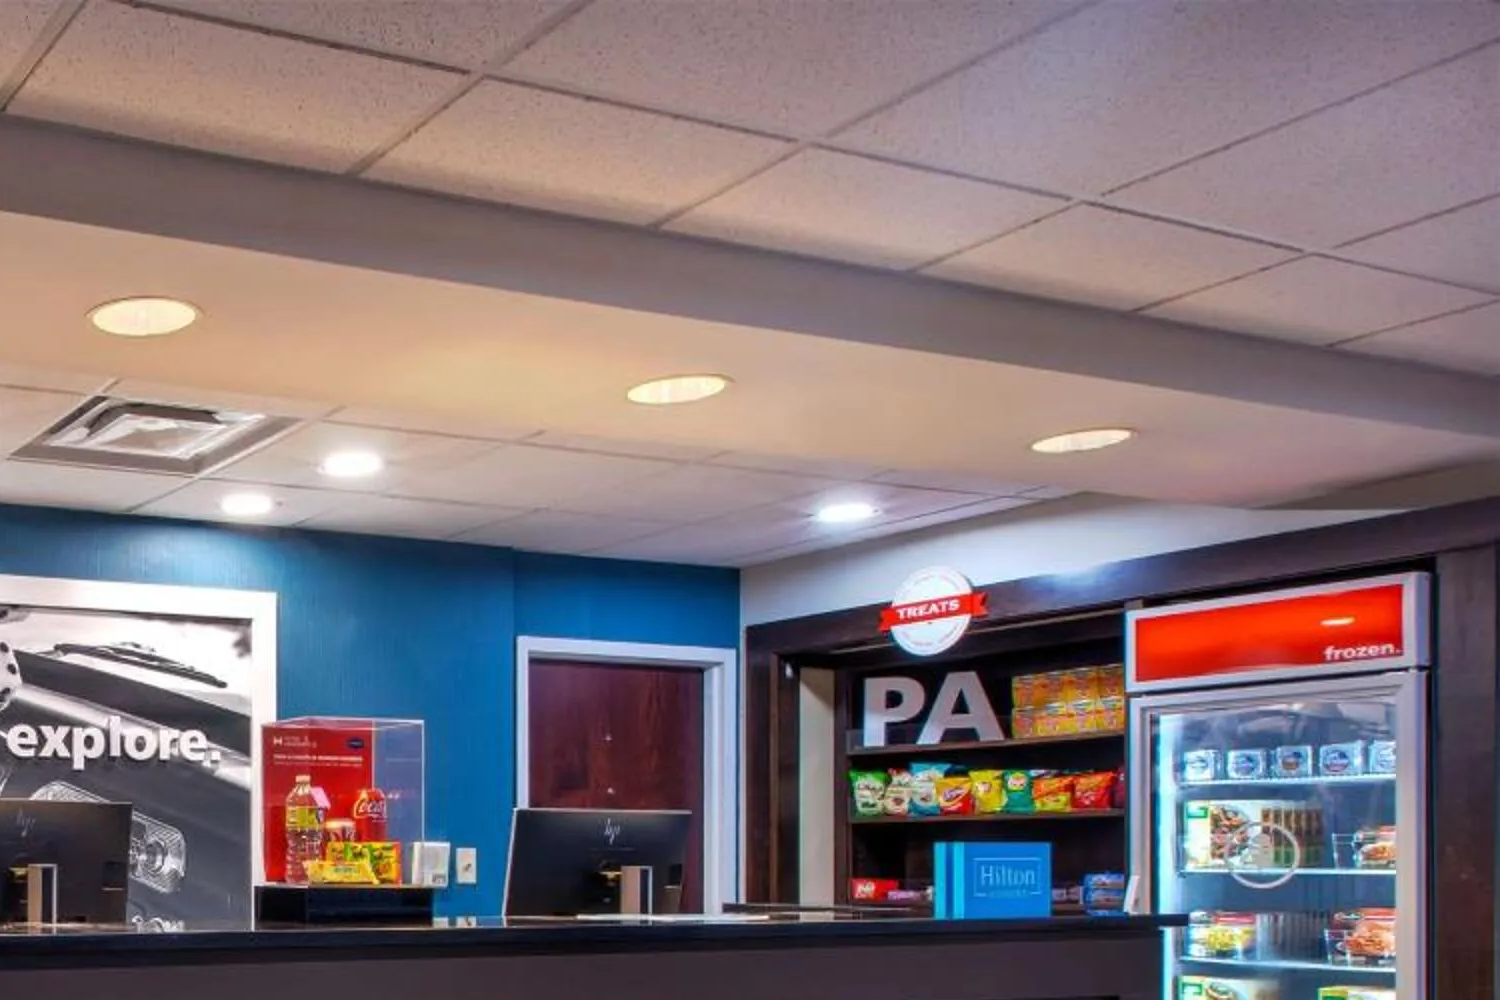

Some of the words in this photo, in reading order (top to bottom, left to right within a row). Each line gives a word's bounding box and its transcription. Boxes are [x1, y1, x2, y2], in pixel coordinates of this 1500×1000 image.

[896, 599, 960, 620] TREATS
[864, 670, 1005, 748] PA
[7, 716, 221, 771] explore.
[981, 864, 1036, 886] Hilton
